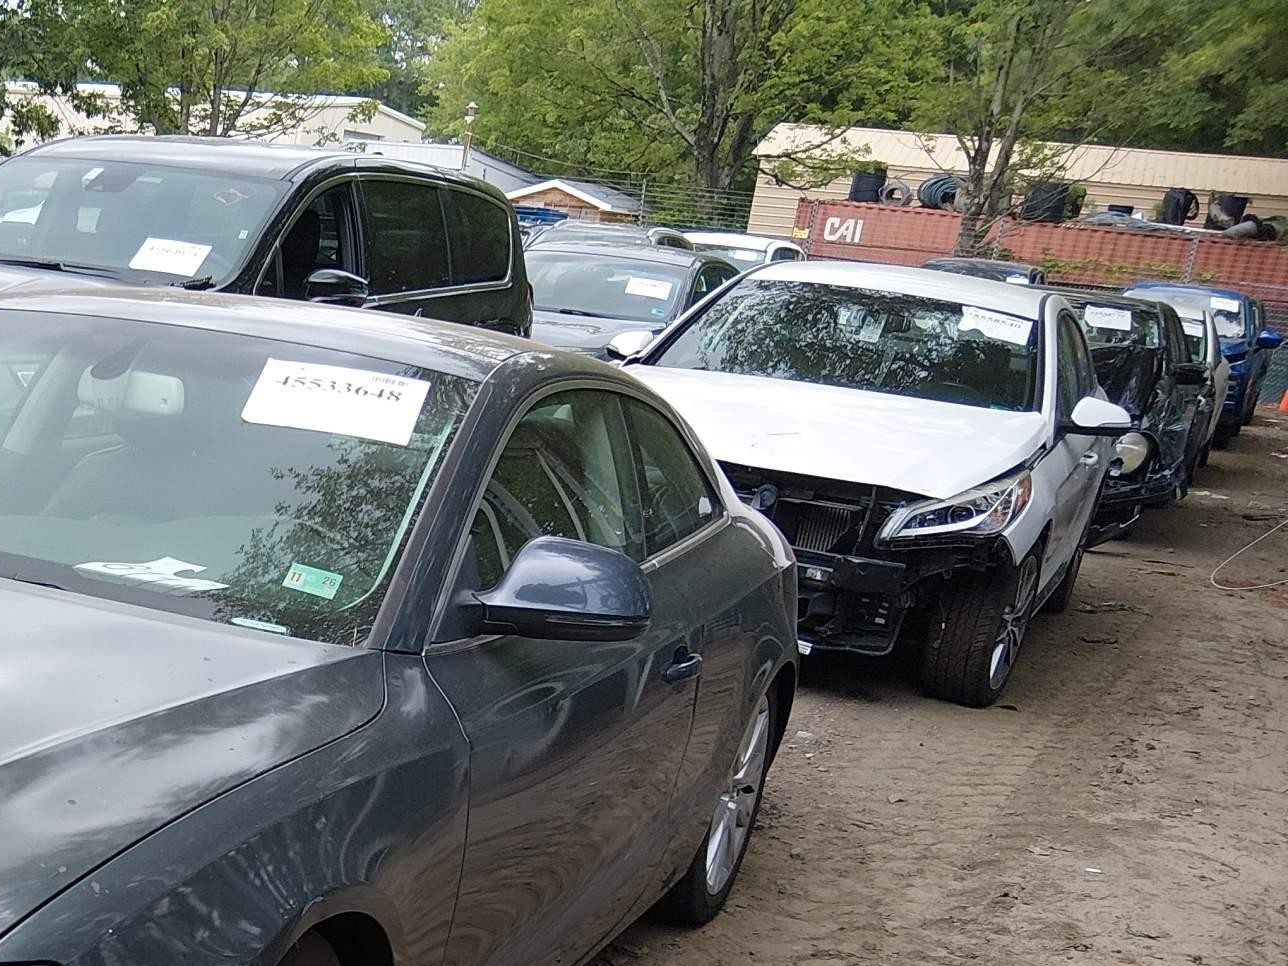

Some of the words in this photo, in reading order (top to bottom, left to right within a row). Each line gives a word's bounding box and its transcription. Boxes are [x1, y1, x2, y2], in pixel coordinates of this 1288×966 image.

[823, 216, 864, 243] CAI
[276, 375, 402, 402] 45533648
[290, 571, 302, 583] 11
[322, 576, 337, 587] 26
